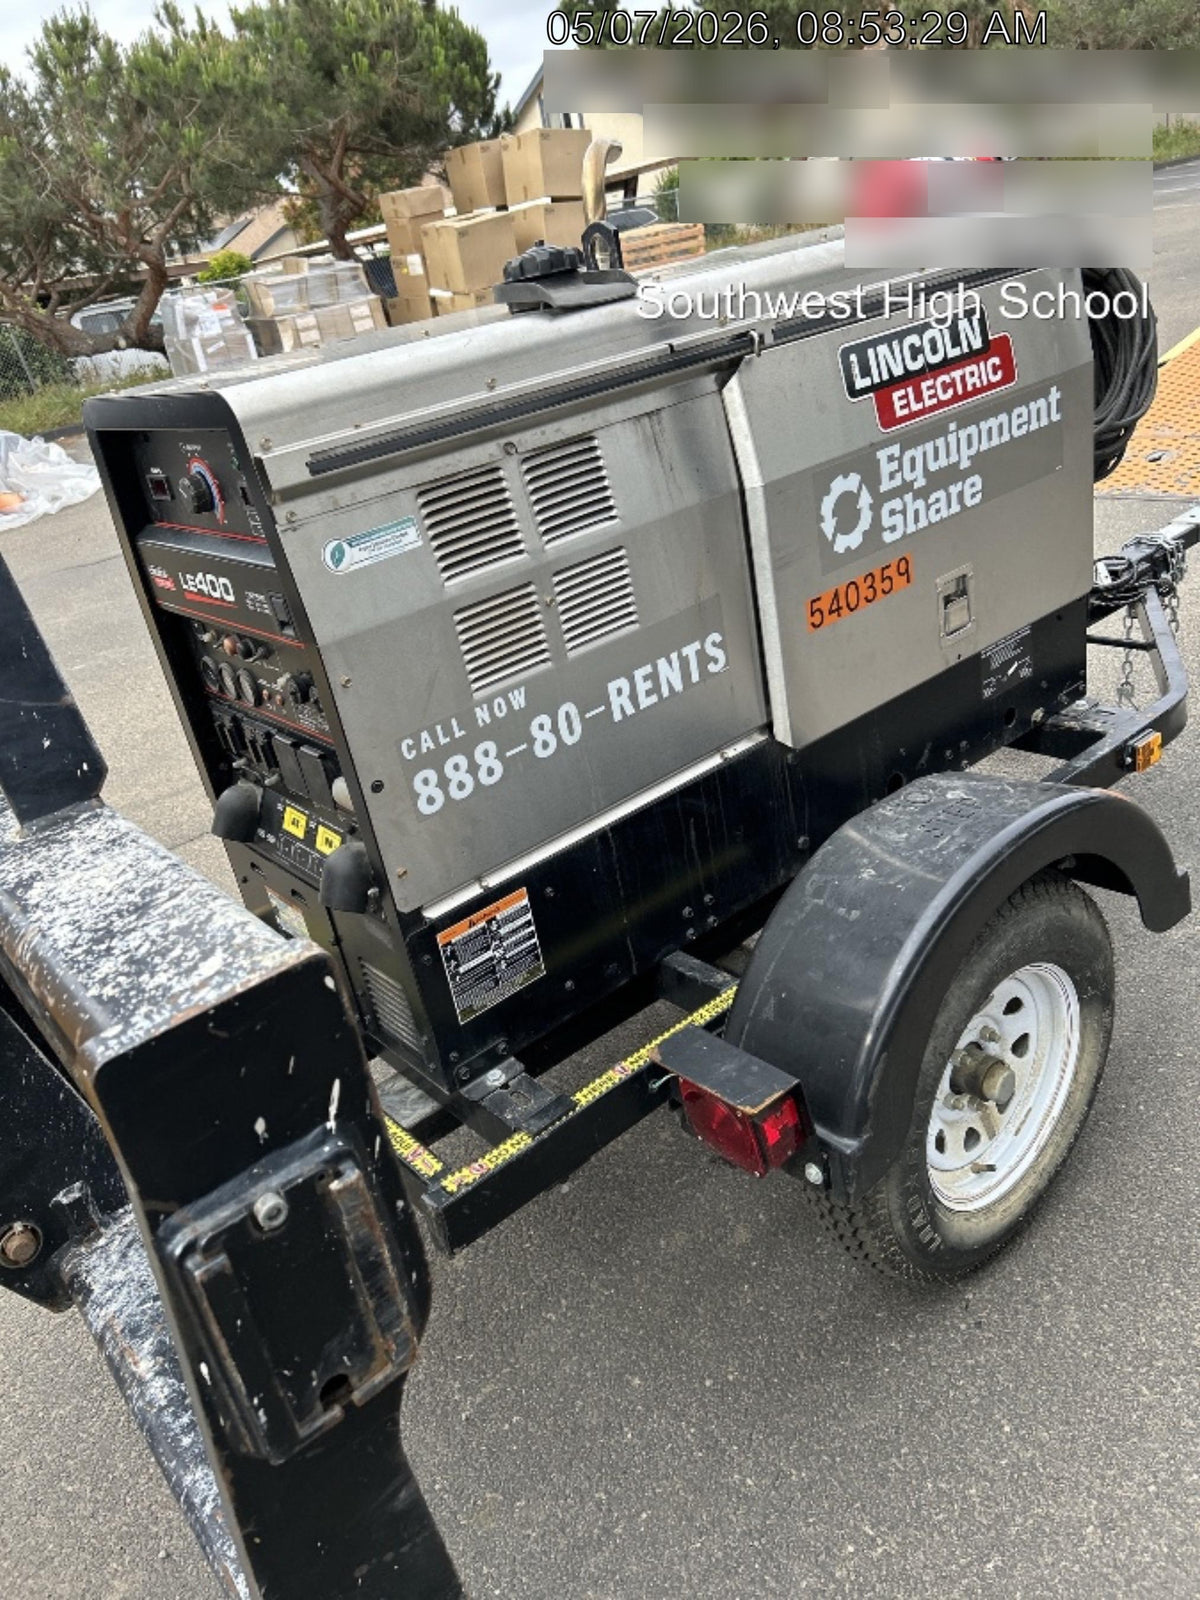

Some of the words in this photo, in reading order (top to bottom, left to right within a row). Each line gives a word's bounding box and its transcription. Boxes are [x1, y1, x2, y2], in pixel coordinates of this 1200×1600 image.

[849, 316, 984, 390] LINCOLN
[892, 356, 1003, 419] ELECTRIC
[876, 386, 1063, 494] Equipment
[880, 472, 984, 545] Share
[808, 556, 912, 630] 540359
[400, 717, 467, 761] CALL
[474, 685, 528, 728] NOW
[412, 632, 727, 815] 888-80-RENTS
